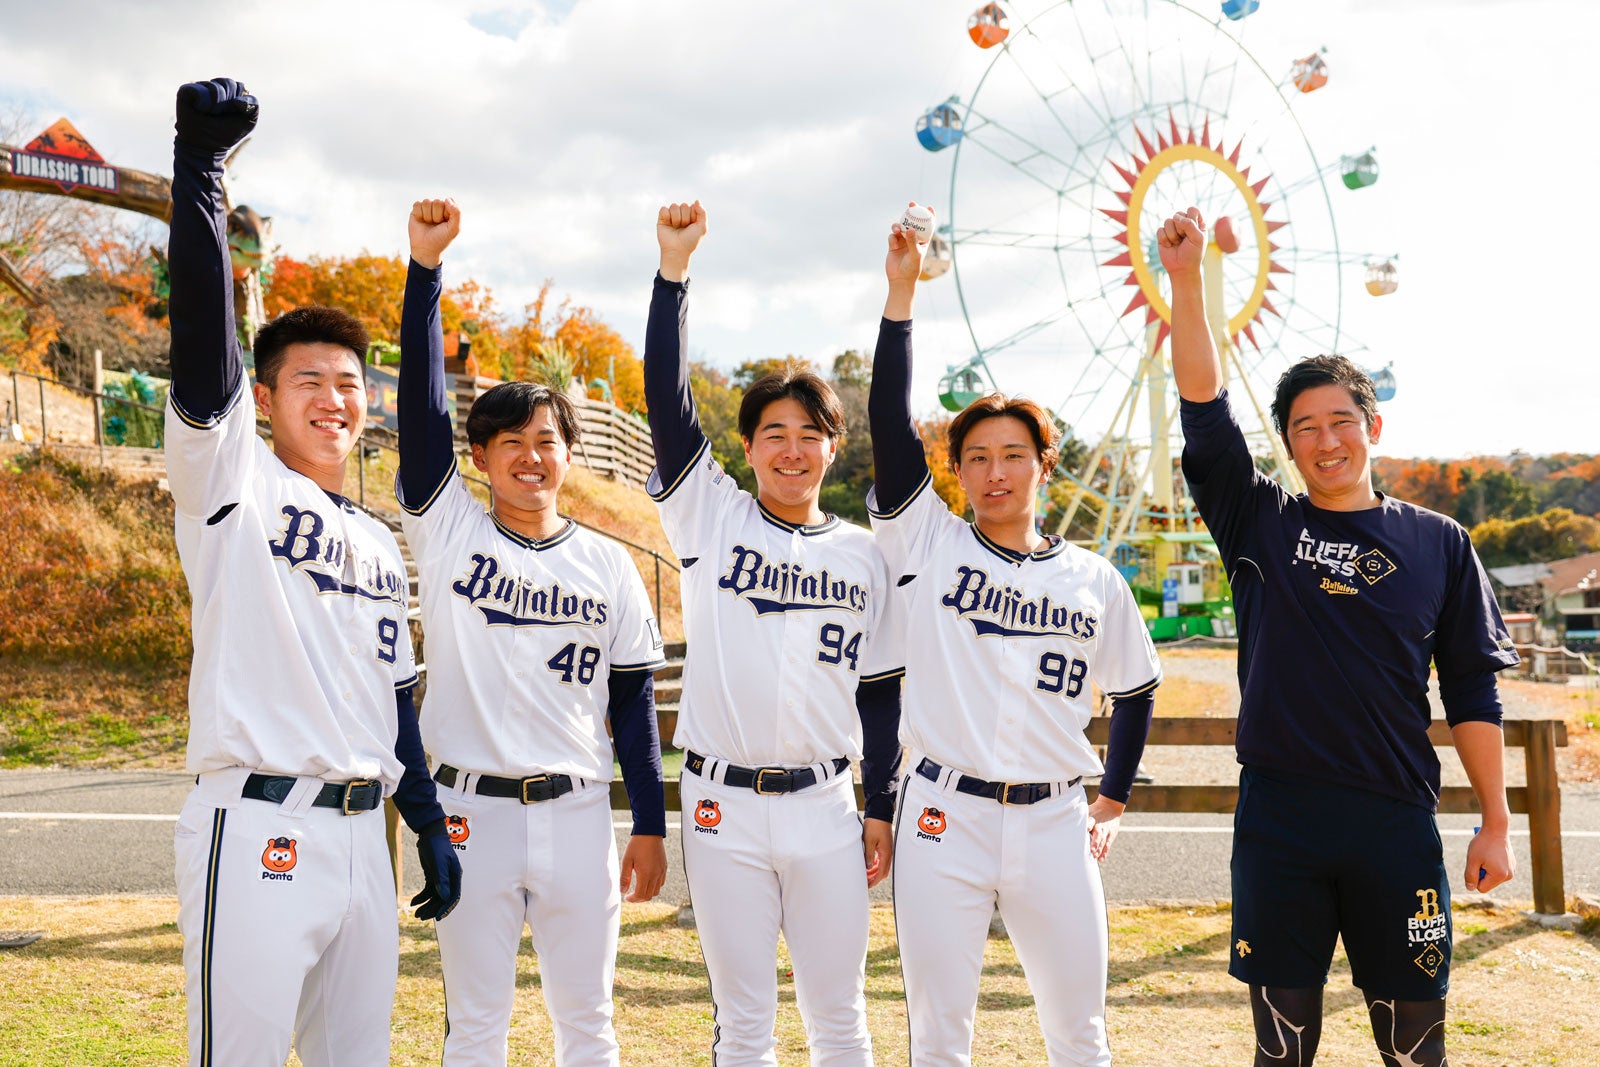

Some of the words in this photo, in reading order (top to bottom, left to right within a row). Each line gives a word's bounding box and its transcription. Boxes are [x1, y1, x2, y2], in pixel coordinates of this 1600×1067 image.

[15, 153, 79, 183] JURASSIC
[81, 164, 116, 190] TOUR
[451, 552, 608, 626] Buffaloes
[718, 544, 867, 613] Buffaloes
[1319, 577, 1359, 595] Buffaloes
[940, 564, 1098, 640] Buffaloes
[376, 616, 399, 666] 9
[546, 641, 601, 686] 48
[816, 622, 863, 671] 94
[1036, 650, 1088, 700] 98
[452, 843, 467, 851] nta
[694, 825, 718, 835] Ponta
[916, 831, 942, 843] Ponta
[262, 871, 293, 881] Ponta
